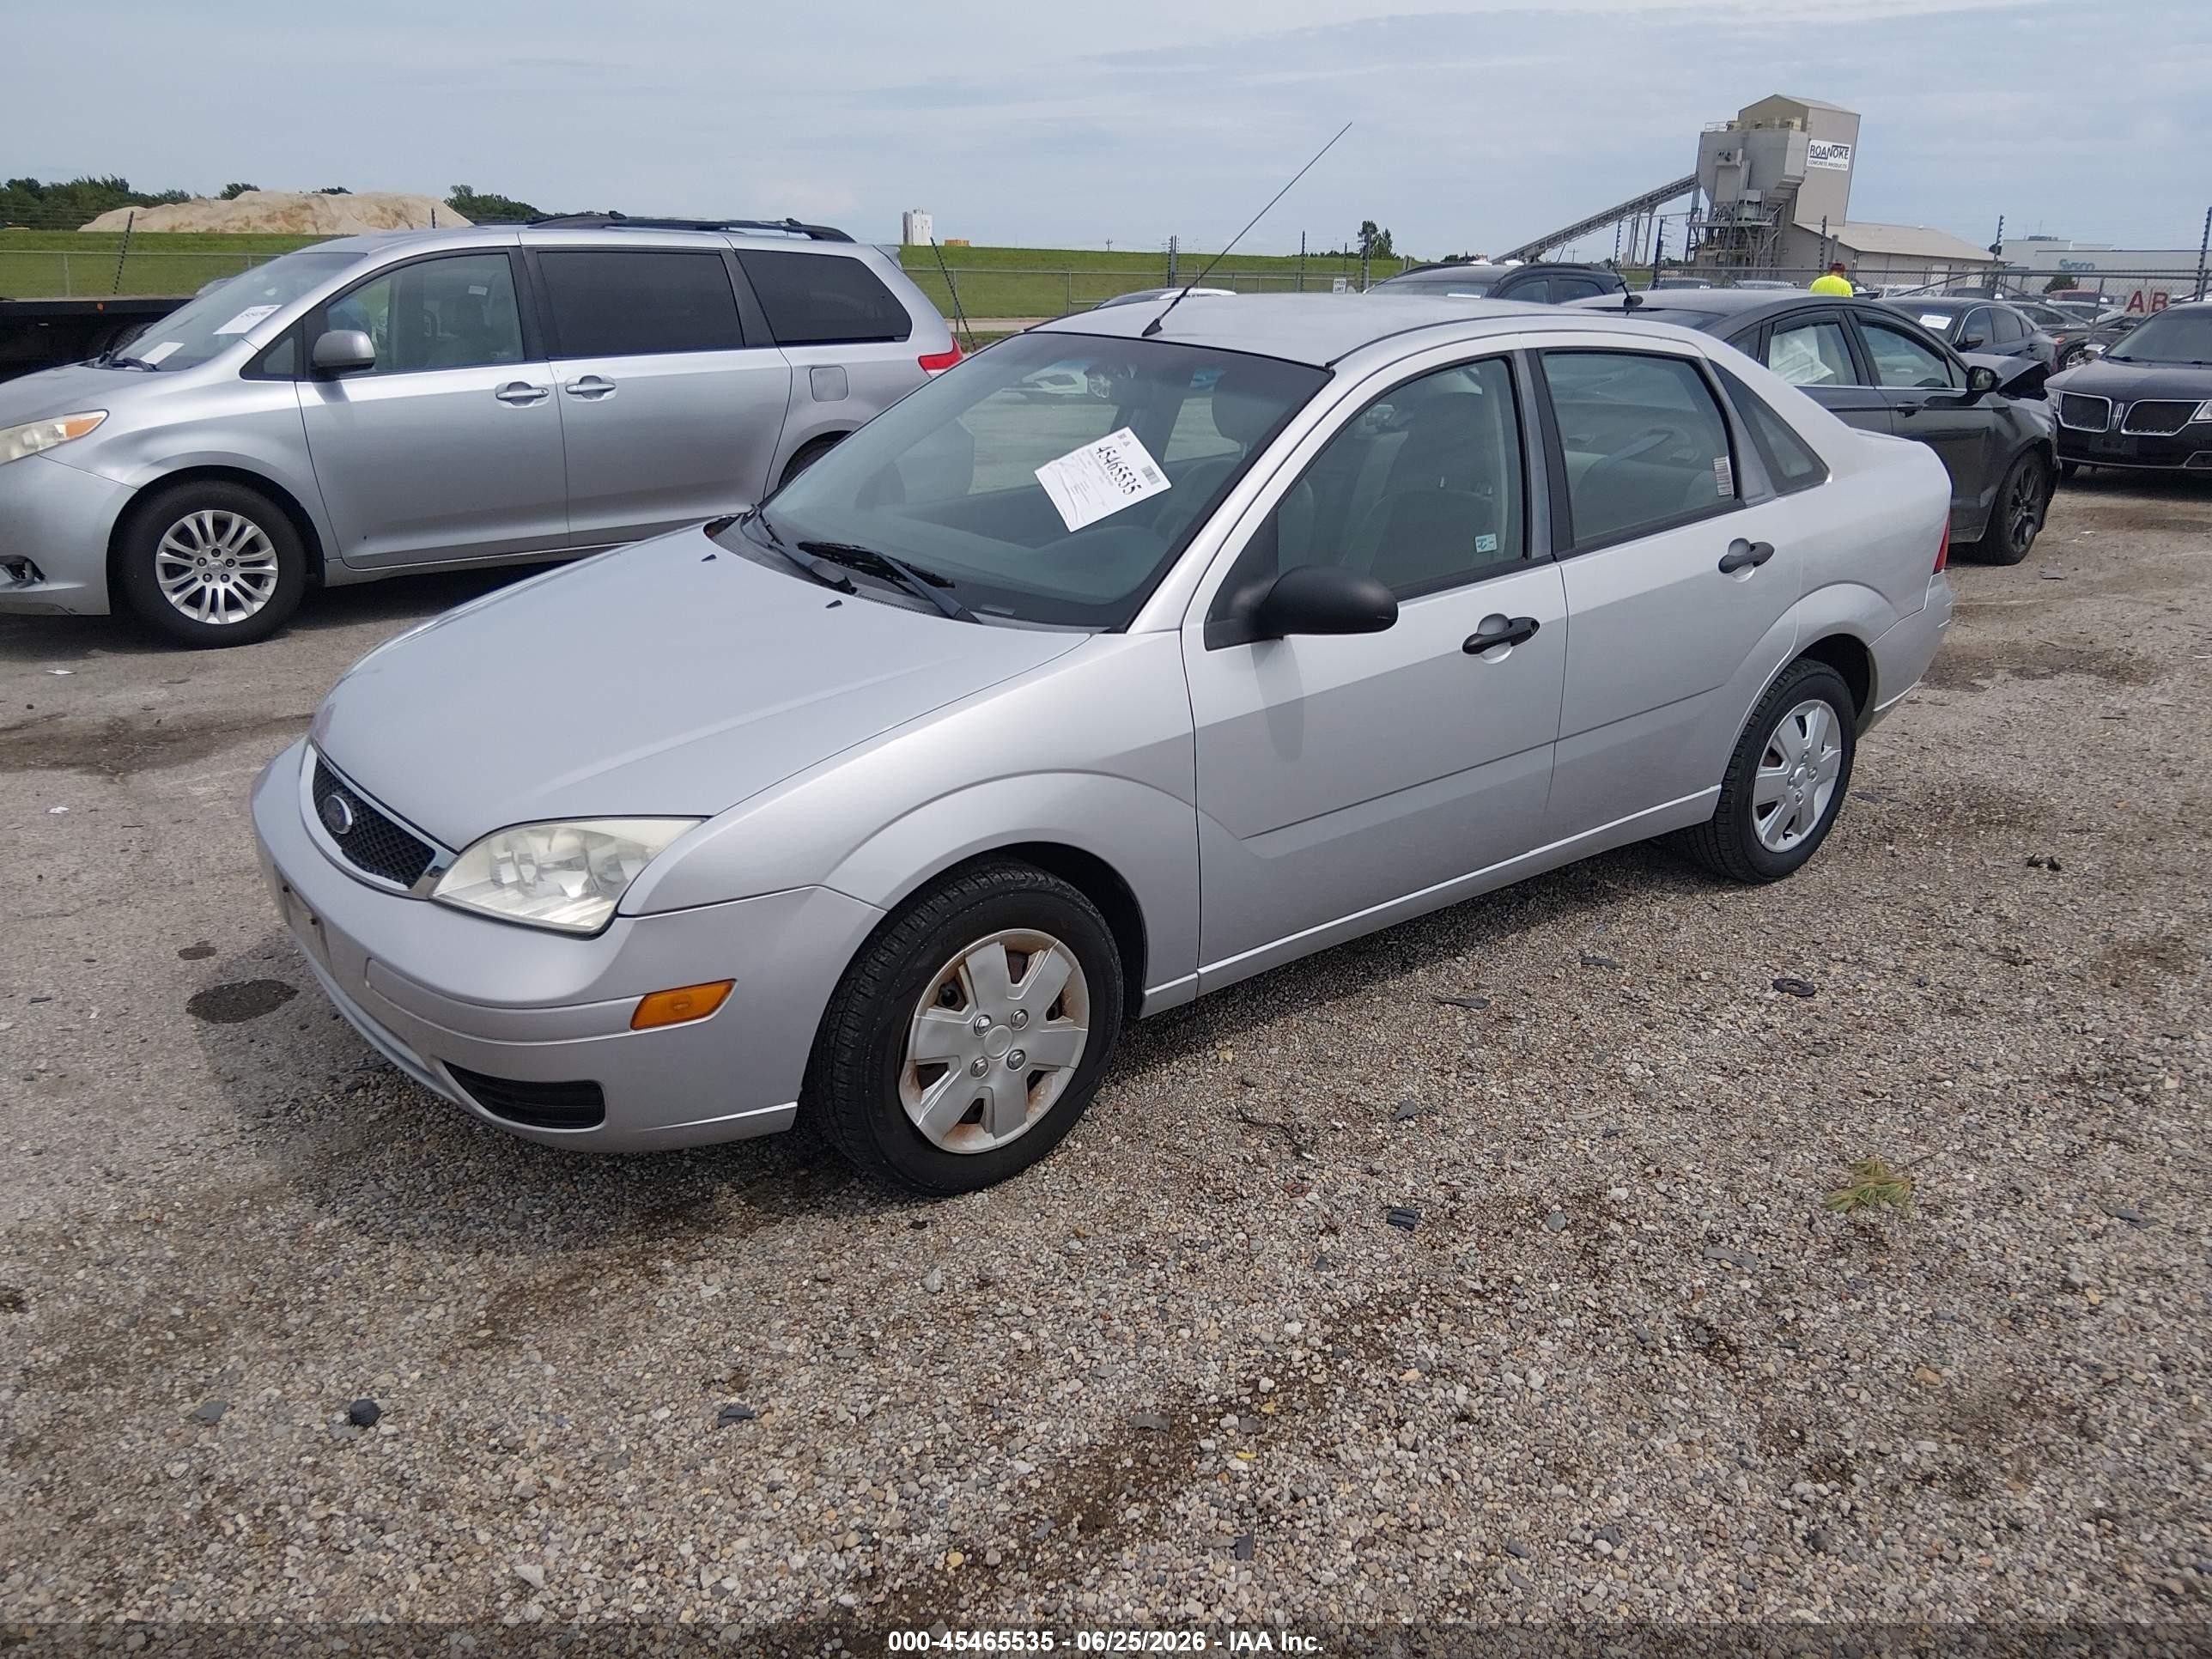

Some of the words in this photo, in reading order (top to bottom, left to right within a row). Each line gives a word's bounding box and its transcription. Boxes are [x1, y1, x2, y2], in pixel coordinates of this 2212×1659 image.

[1809, 144, 1850, 160] ROANOKE
[2126, 290, 2145, 313] A
[2151, 291, 2170, 313] B
[1096, 446, 1142, 495] 45465535
